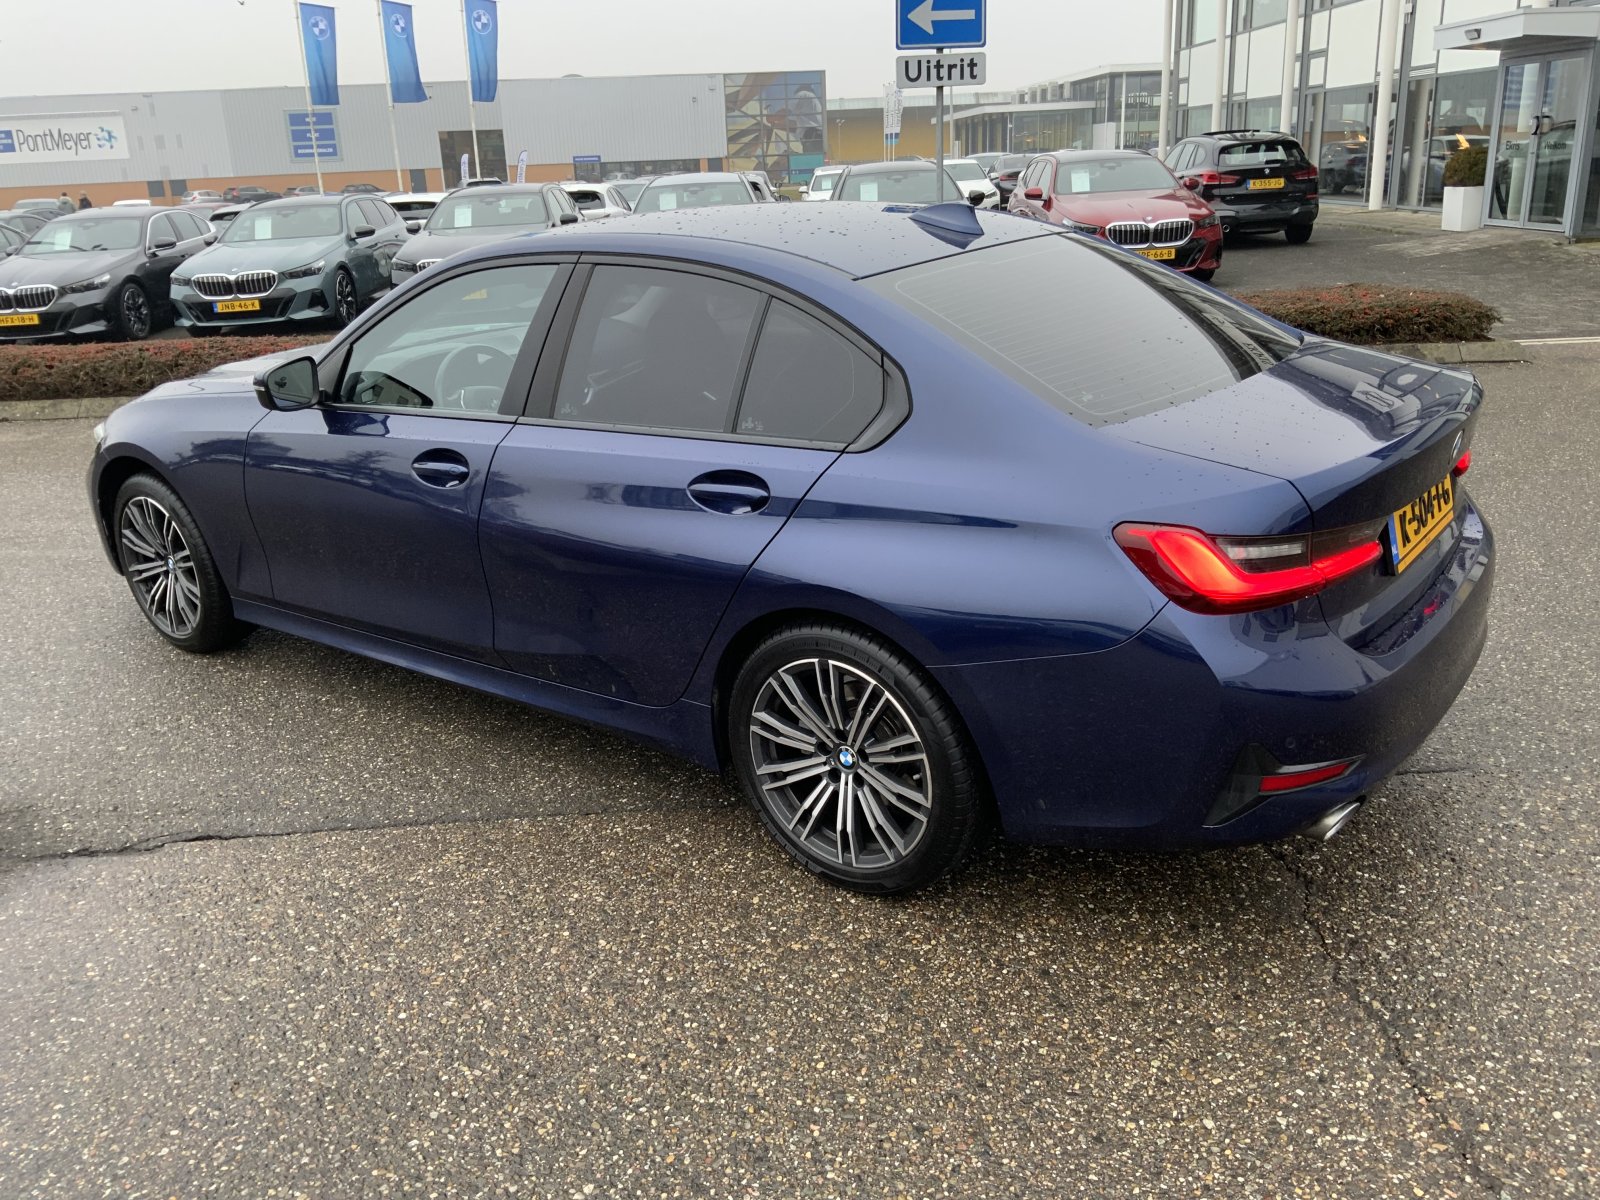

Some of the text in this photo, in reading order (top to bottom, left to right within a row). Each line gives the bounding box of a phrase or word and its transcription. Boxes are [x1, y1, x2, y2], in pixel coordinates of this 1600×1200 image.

[904, 57, 978, 83] Uitrit
[15, 127, 92, 156] PontMeyer
[220, 301, 257, 311] JNB-46-K
